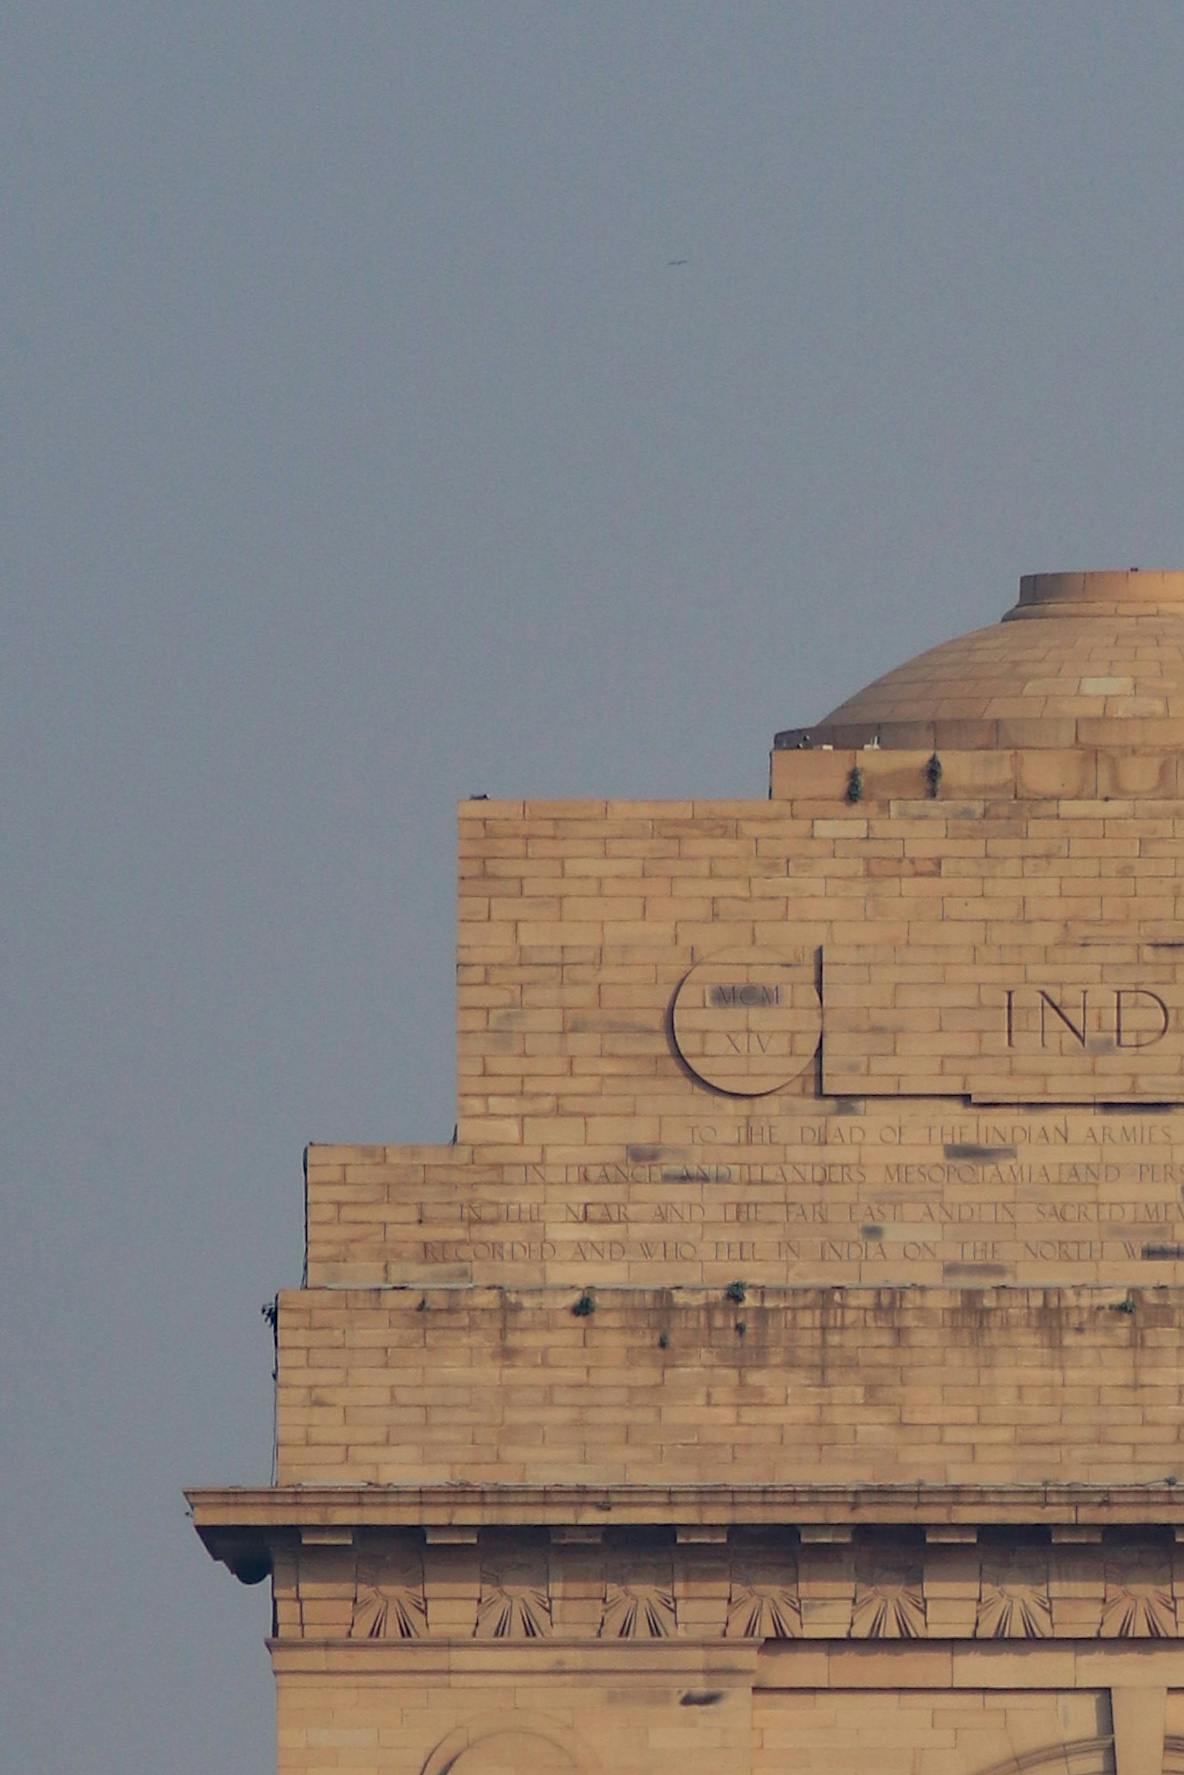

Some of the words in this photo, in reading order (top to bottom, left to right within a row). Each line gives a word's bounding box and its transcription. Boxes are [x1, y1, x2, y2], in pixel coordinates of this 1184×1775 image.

[718, 984, 782, 1005] MCM
[724, 1033, 774, 1053] XIV
[687, 1125, 718, 1144] TO
[737, 1125, 778, 1144] THE
[801, 1125, 867, 1143] DEAD
[879, 1125, 908, 1143] OF
[928, 1125, 969, 1143] THE
[985, 1125, 1069, 1143] INDIAN
[1085, 1125, 1172, 1143] ARMIES
[524, 1165, 546, 1183] IN
[678, 1165, 732, 1183] AND
[883, 1164, 1051, 1182] MESOPOTAMIA
[1067, 1164, 1122, 1182] AND
